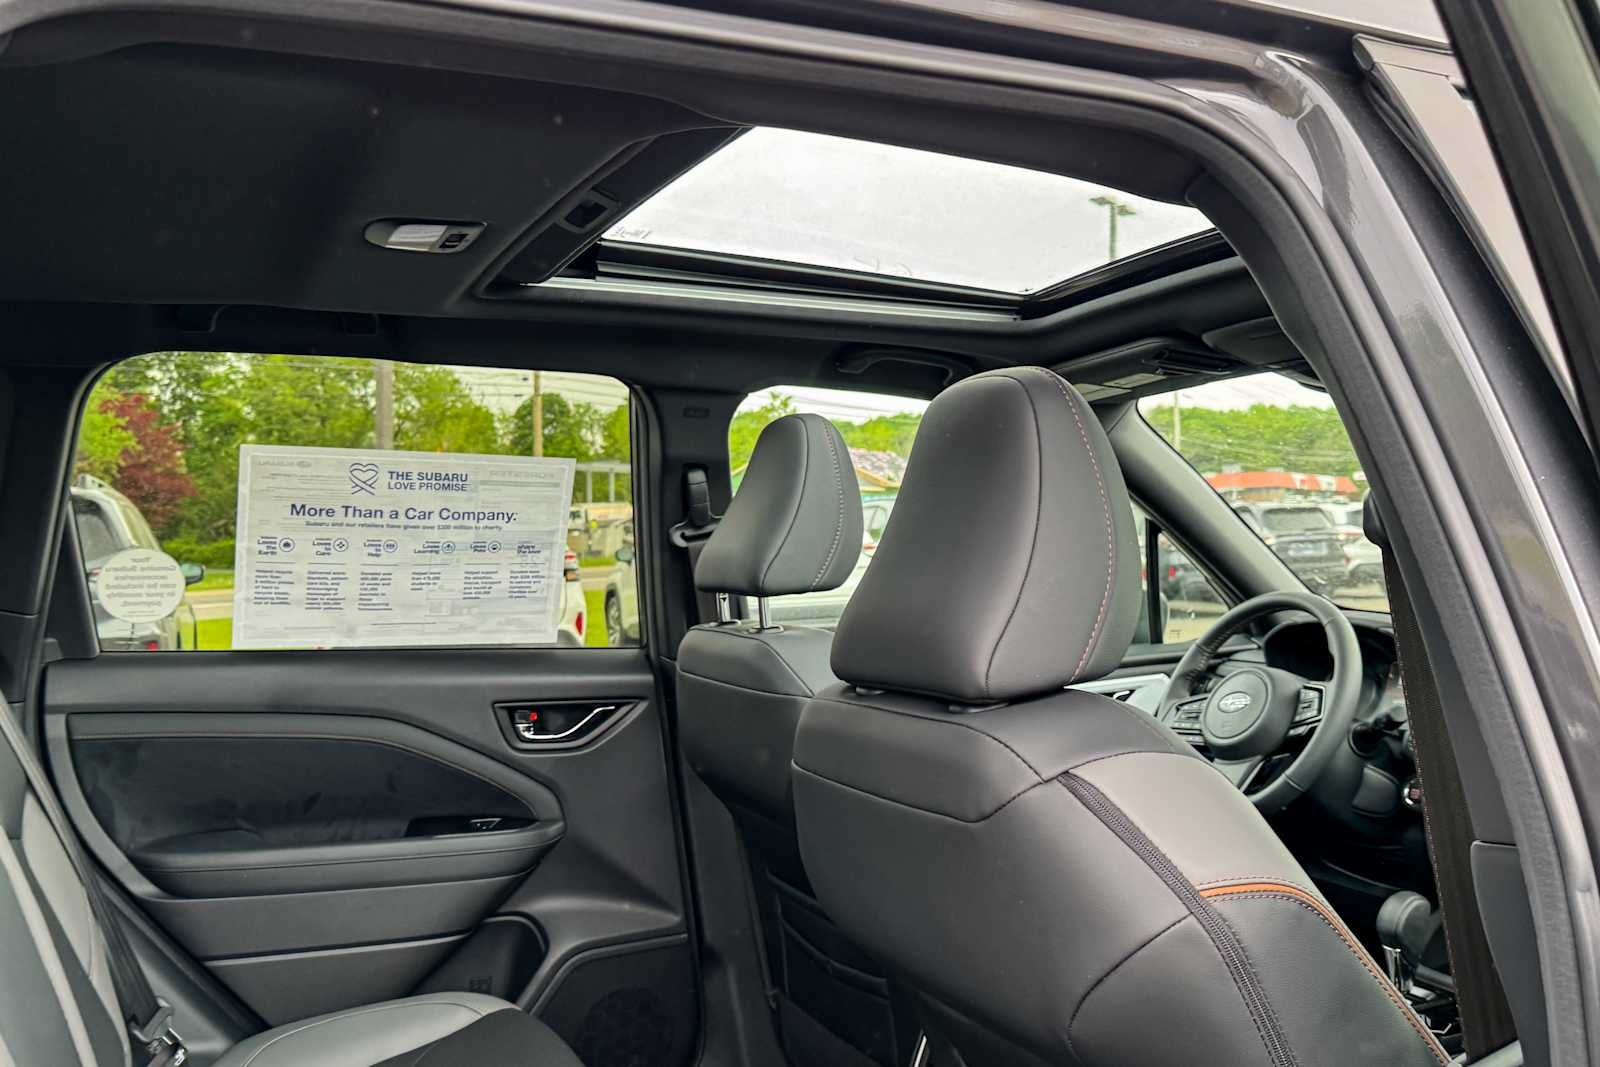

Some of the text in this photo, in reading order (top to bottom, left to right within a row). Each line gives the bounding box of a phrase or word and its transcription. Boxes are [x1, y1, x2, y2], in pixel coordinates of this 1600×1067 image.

[388, 471, 468, 482] THE SUBARU
[388, 481, 467, 491] LOVE PROMISE
[290, 503, 335, 517] More
[341, 505, 383, 518] Than
[389, 508, 399, 519] a
[404, 507, 434, 520] Car
